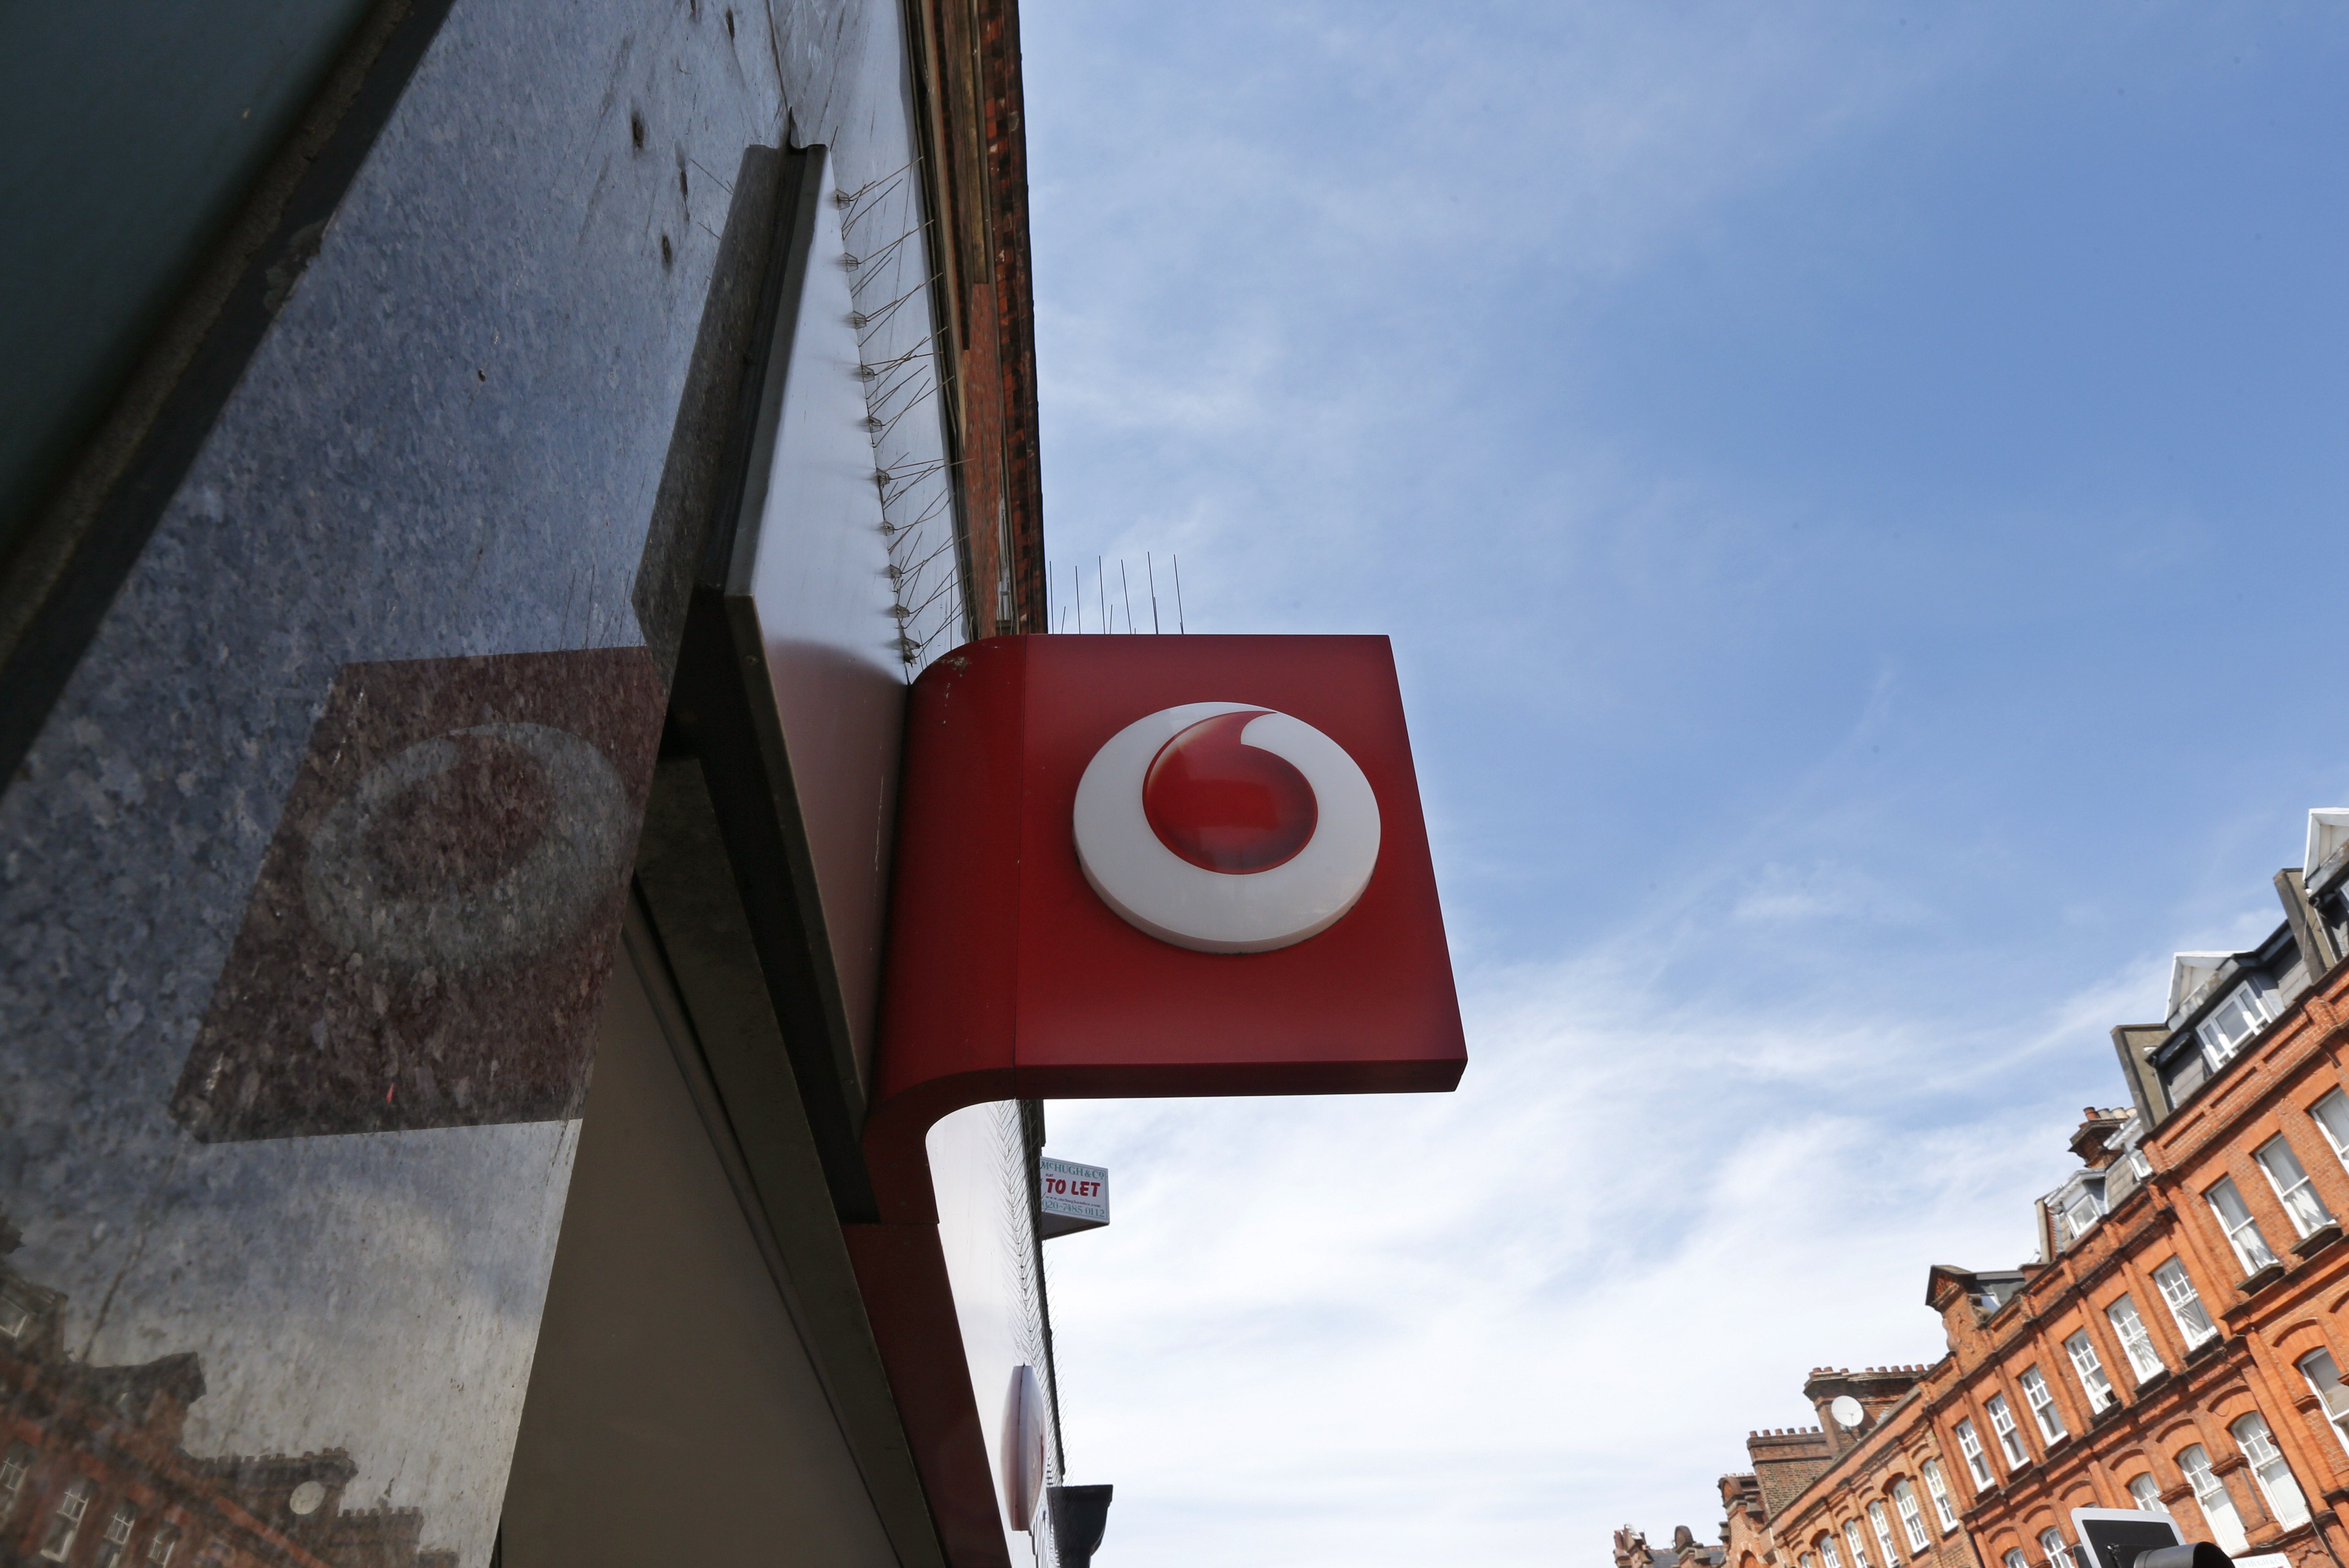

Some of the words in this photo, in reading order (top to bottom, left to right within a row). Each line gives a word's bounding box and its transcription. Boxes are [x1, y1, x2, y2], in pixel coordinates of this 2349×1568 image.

[1046, 1178, 1066, 1194] TO
[1071, 1181, 1100, 1197] LET
[1085, 1207, 1104, 1217] 0112
